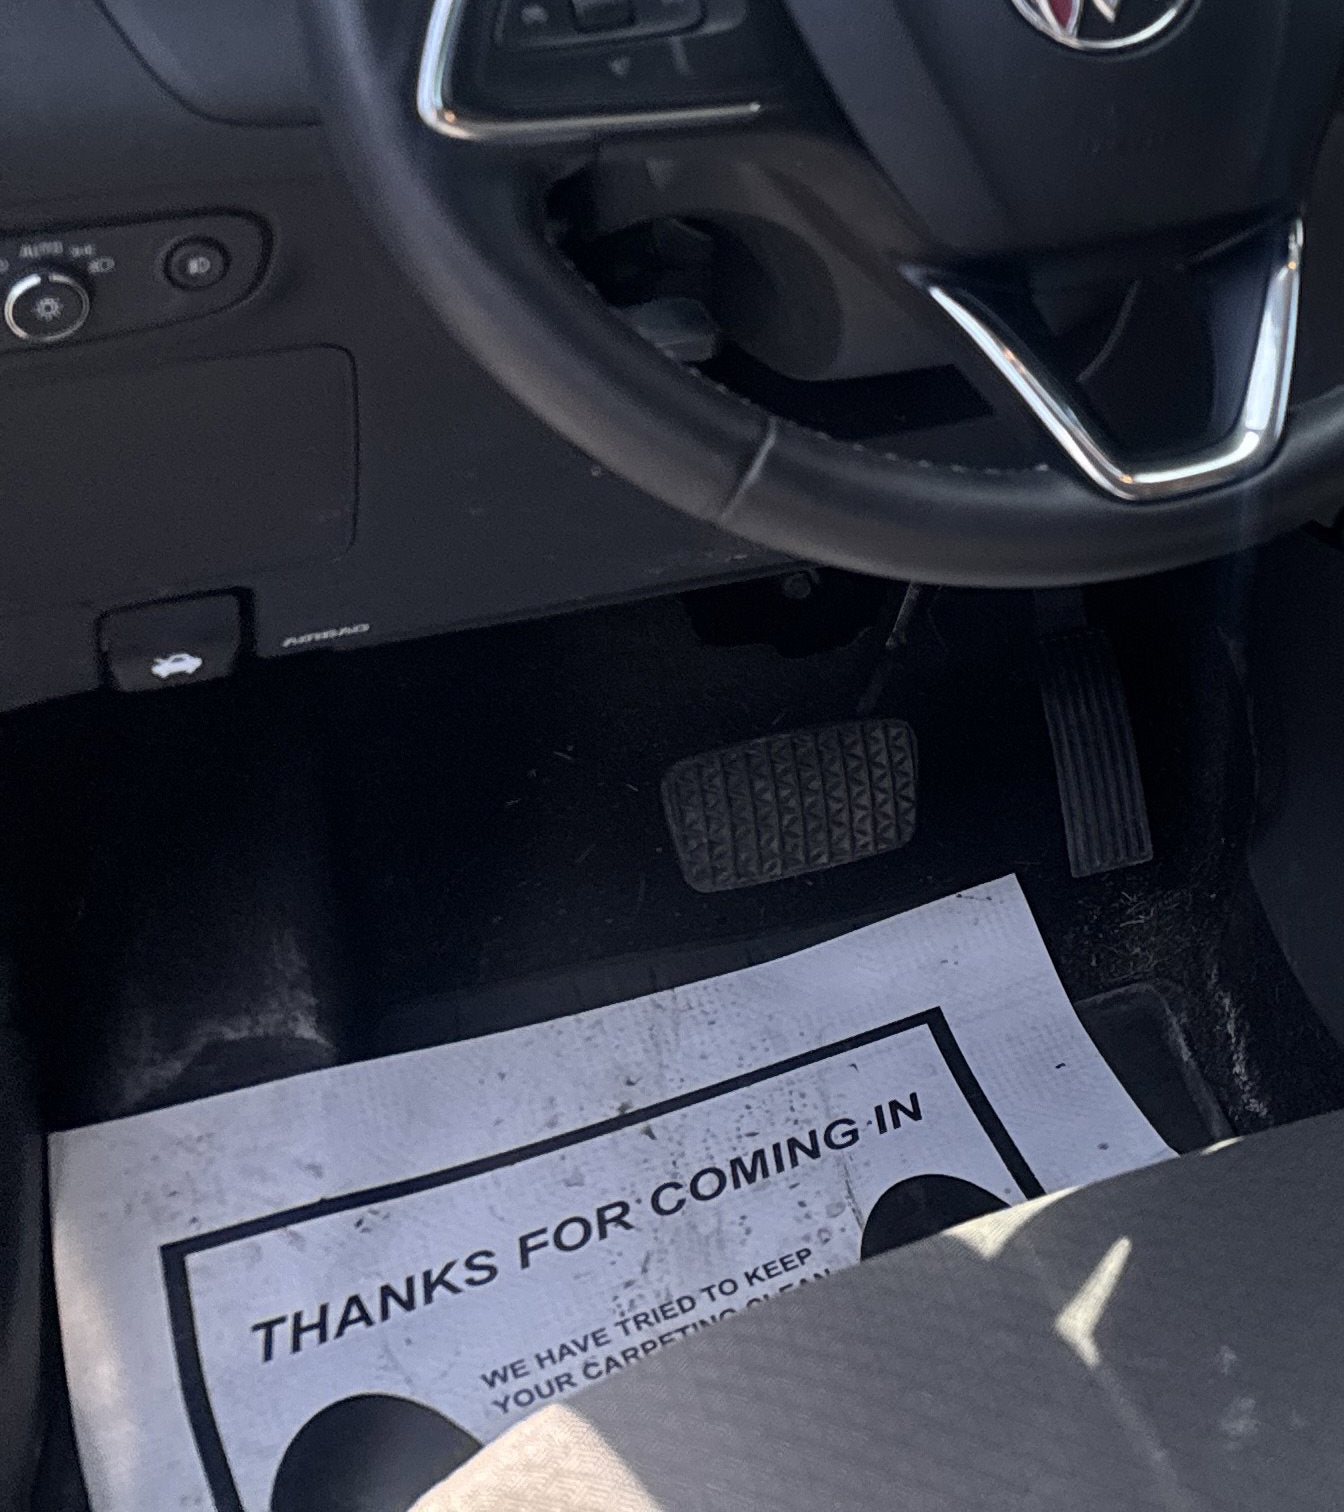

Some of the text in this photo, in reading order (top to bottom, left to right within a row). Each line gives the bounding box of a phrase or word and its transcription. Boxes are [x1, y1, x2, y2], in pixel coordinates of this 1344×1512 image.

[250, 1091, 924, 1363] THANKS FOR COMING IN
[481, 1356, 531, 1390] WE
[534, 1327, 613, 1370] HAVE
[614, 1292, 697, 1340] TRIED
[701, 1277, 739, 1304] TO
[744, 1246, 814, 1285] KEEP
[490, 1371, 578, 1416] YOUR
